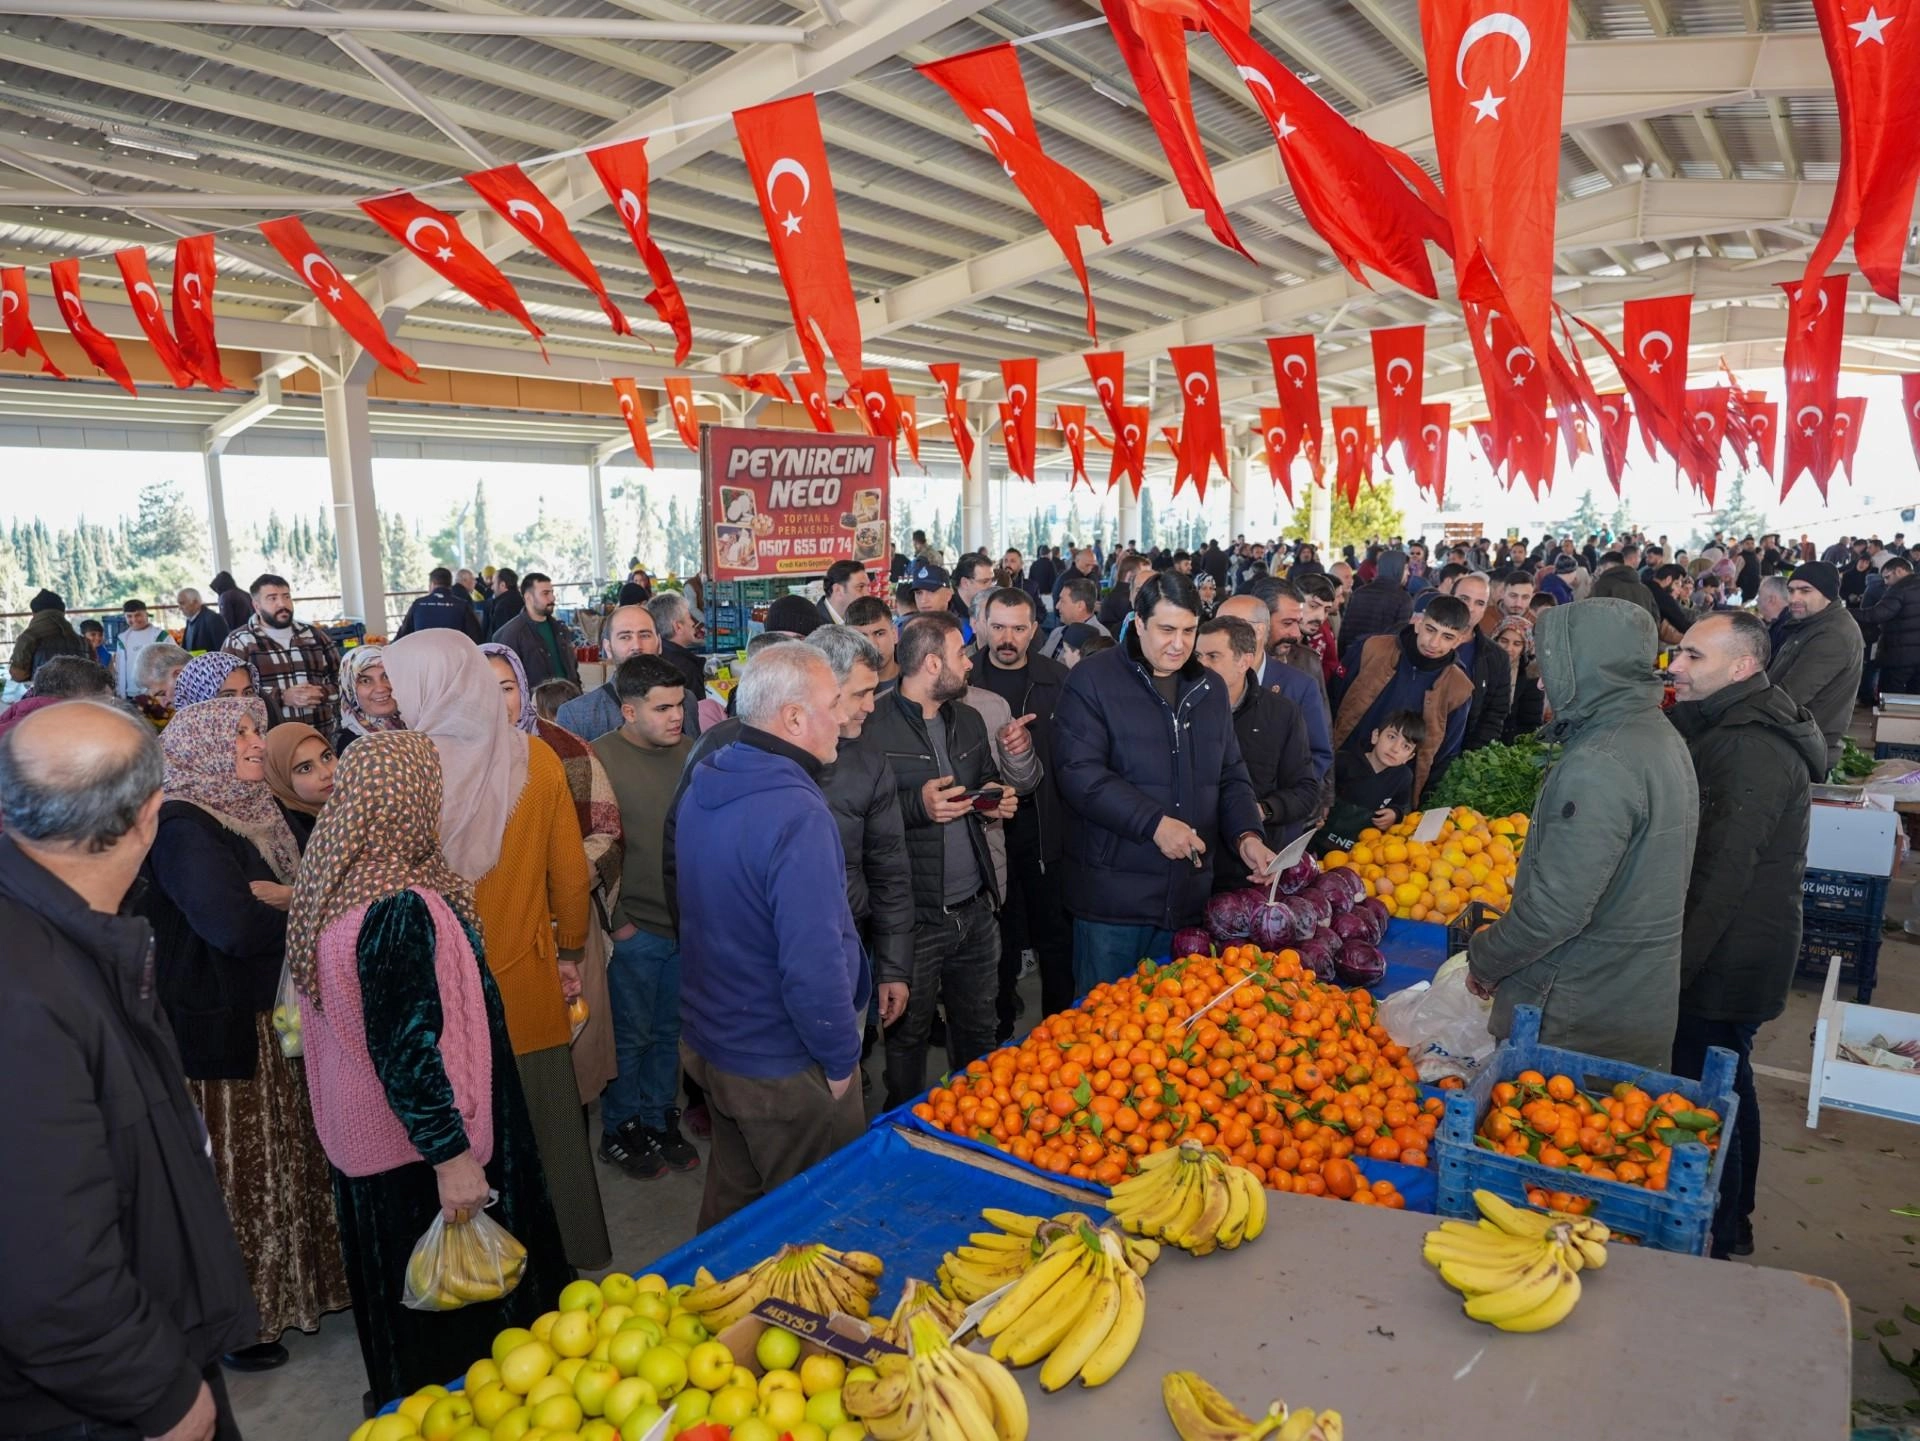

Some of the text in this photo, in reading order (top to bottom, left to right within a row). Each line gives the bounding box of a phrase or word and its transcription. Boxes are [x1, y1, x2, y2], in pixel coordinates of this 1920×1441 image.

[768, 477, 841, 509] NECO
[783, 513, 830, 524] TOPTAN &
[777, 525, 835, 536] PERAKENDE
[758, 537, 852, 557] 0507 655 07 74
